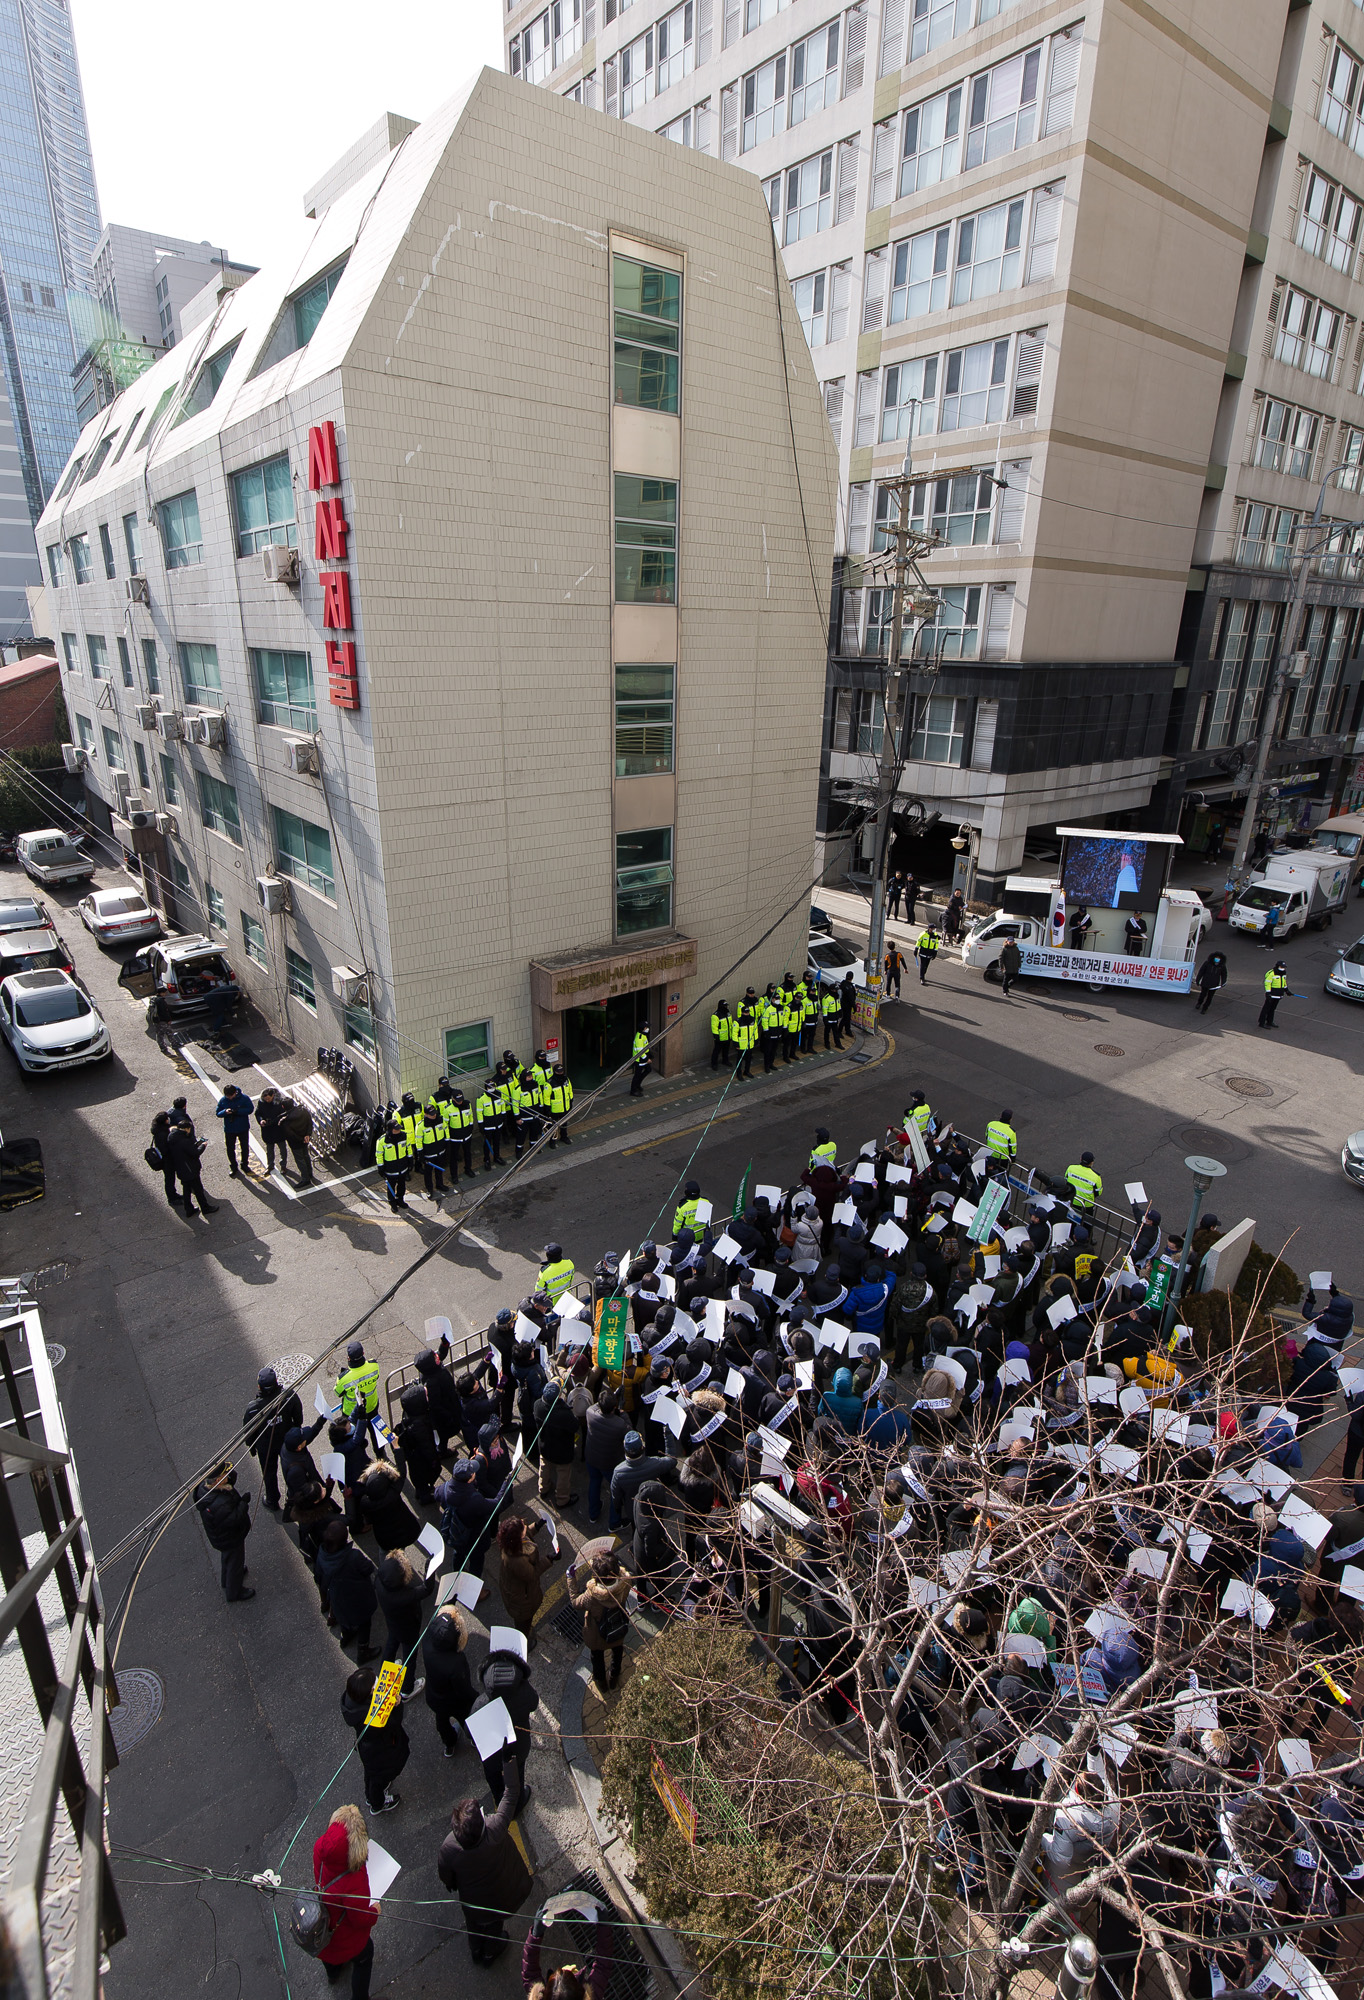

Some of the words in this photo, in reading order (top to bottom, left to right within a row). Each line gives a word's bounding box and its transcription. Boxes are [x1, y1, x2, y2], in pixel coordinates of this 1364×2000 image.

[309, 420, 360, 710] 시사저널
[1071, 972, 1130, 985] 대한민국재향군인회
[1149, 965, 1166, 980] 언론
[603, 1315, 621, 1366] 마포향군
[350, 1375, 379, 1392] PLICE
